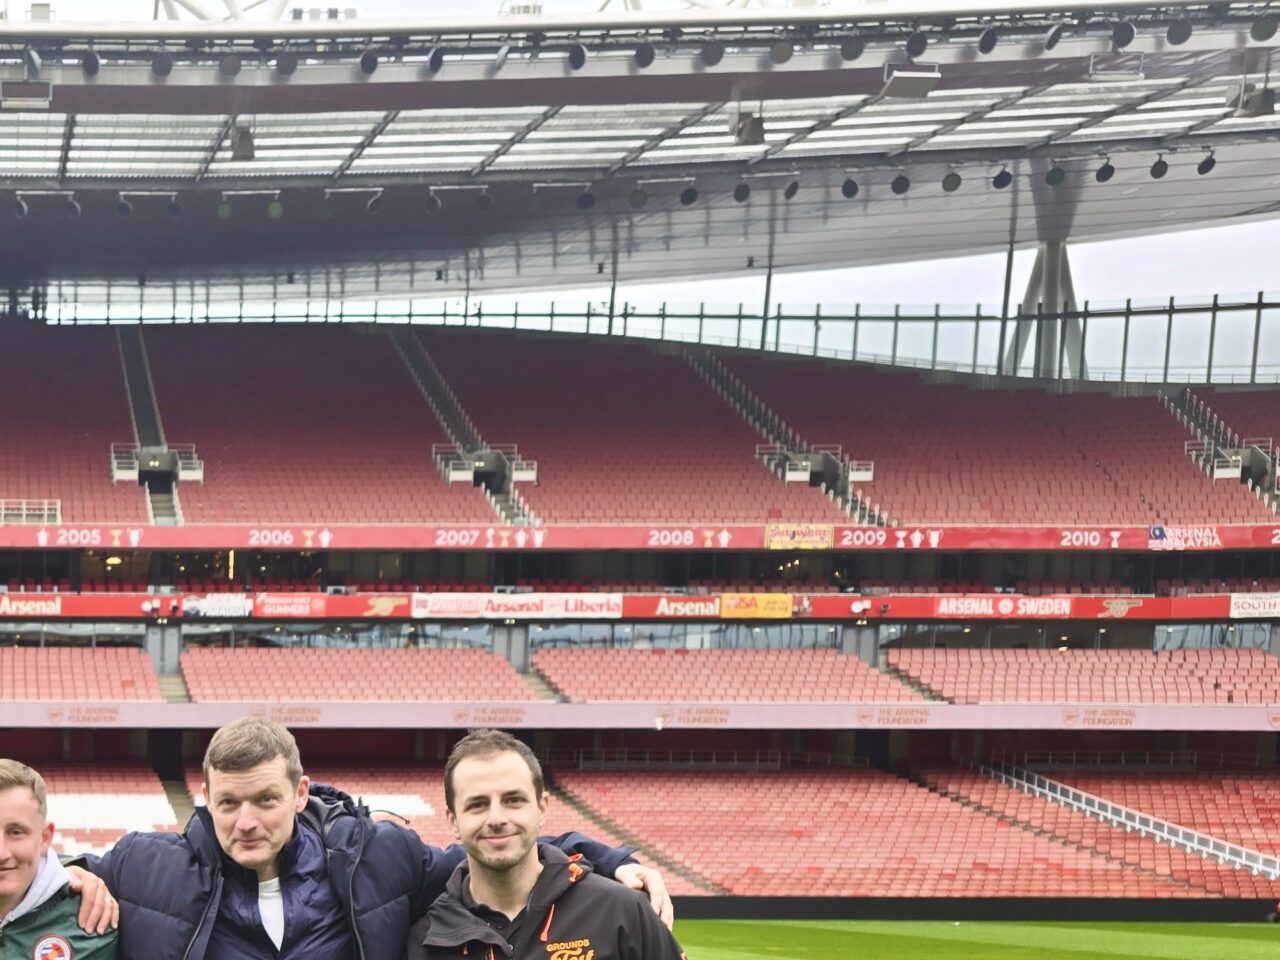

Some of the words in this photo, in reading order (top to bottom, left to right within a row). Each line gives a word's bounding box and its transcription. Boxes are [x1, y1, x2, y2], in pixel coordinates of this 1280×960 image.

[56, 529, 102, 544] 2005
[248, 529, 294, 545] 2006
[435, 529, 480, 545] 2007
[648, 530, 694, 545] 2008
[841, 530, 887, 546] 2009
[1060, 531, 1101, 546] 2010
[1167, 527, 1217, 538] ARSENAL
[485, 599, 543, 612] Arsenal
[564, 599, 620, 612] Liberia
[656, 597, 720, 616] Arsenal
[939, 598, 993, 615] ARSENAL
[1017, 598, 1072, 615] SWEDEN
[1234, 600, 1276, 610] SOUTH
[1084, 709, 1098, 717] THE
[1101, 709, 1136, 717] ARSENAL
[1083, 717, 1132, 725] FOUNDATION
[546, 938, 591, 952] GROUNDS
